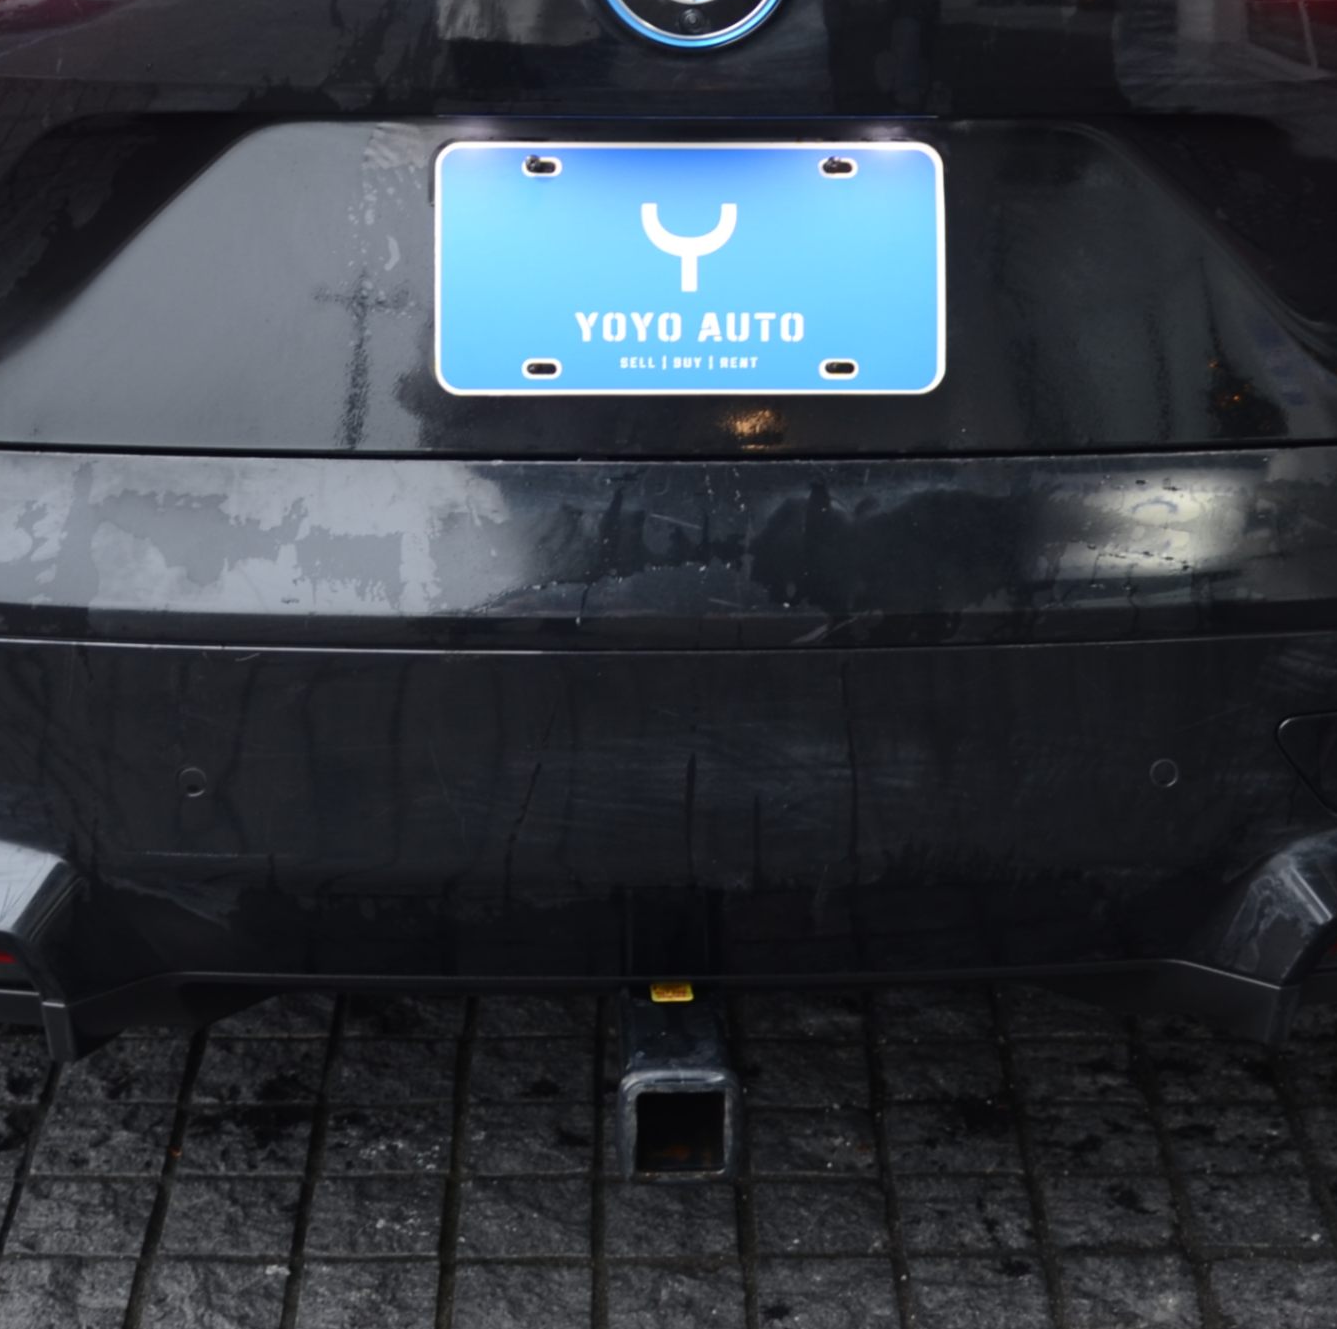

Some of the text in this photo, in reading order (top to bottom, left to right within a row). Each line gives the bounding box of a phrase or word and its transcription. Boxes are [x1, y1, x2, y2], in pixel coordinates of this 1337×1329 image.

[575, 312, 804, 342] YOYO AUTO
[620, 357, 758, 369] SELL BUY RENT
